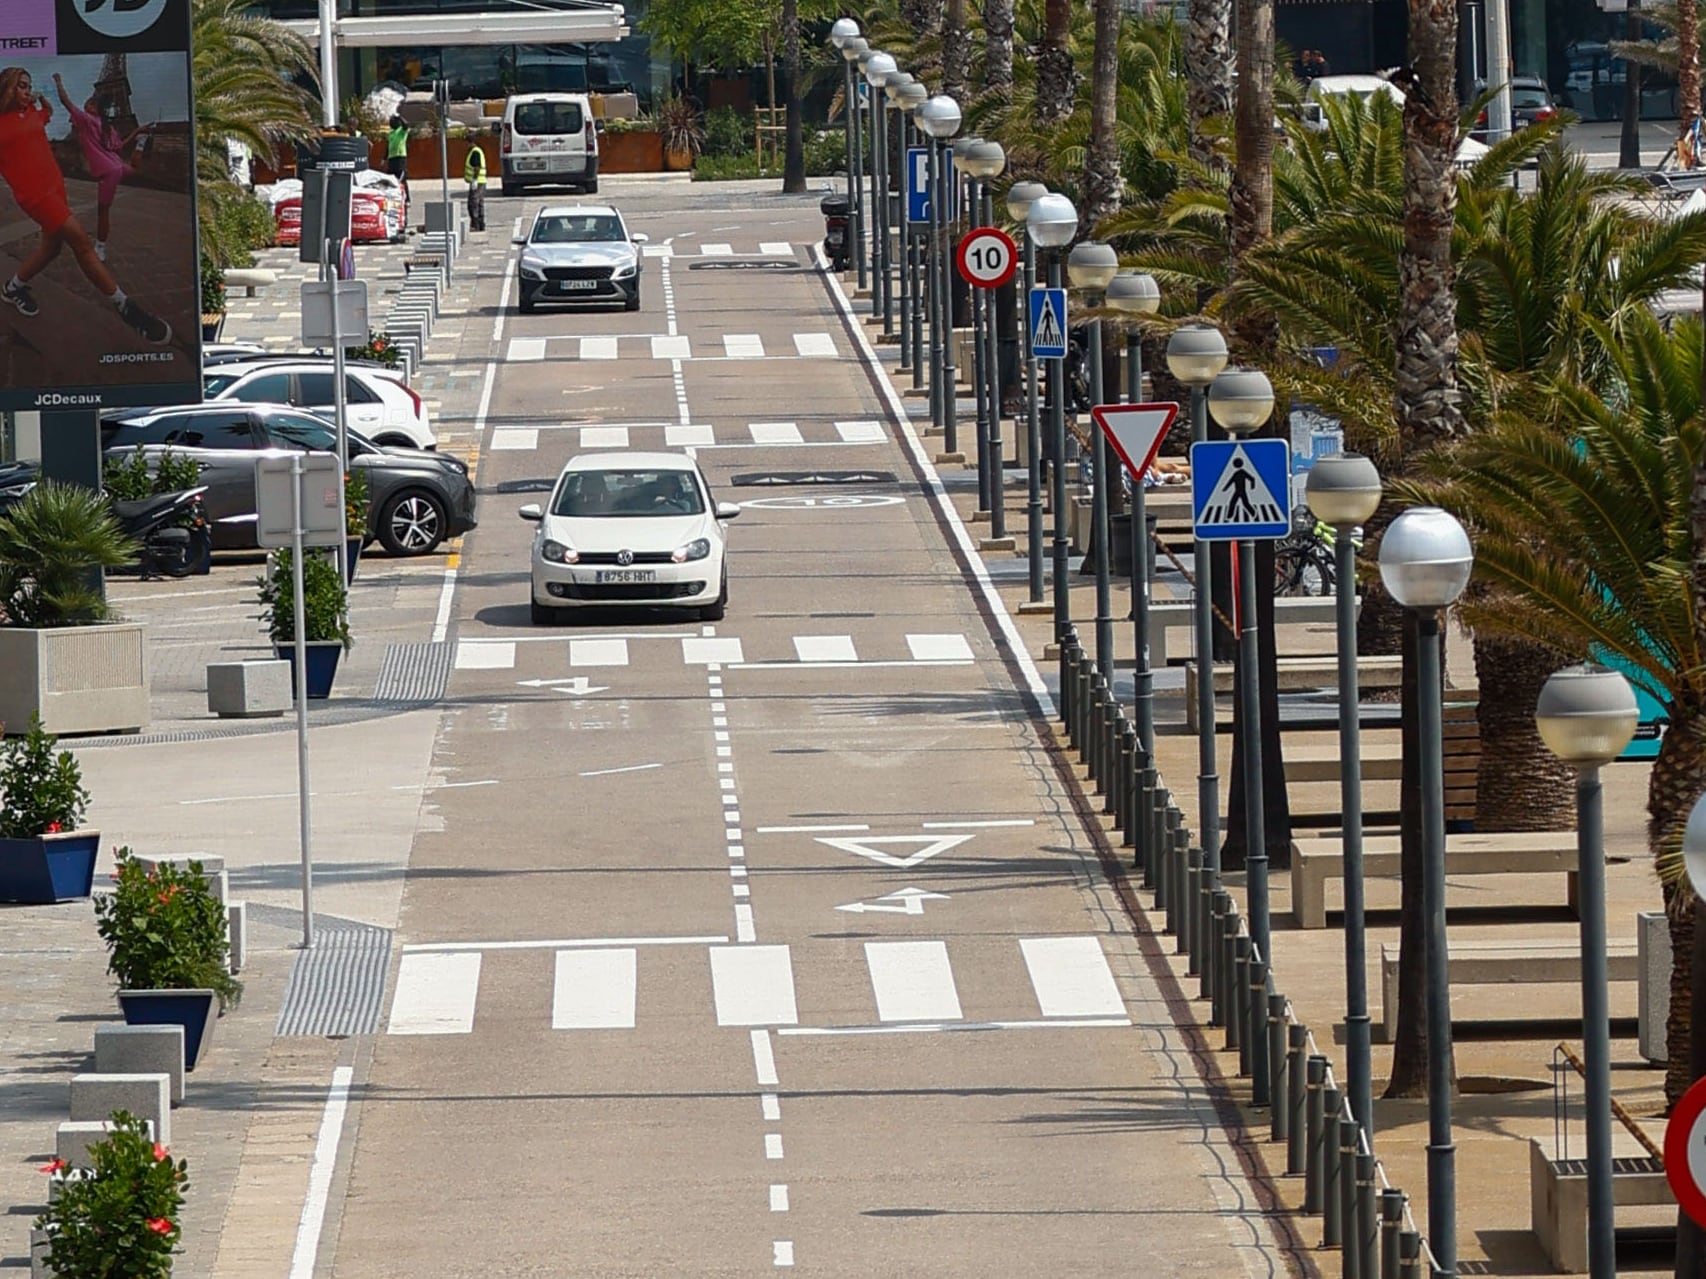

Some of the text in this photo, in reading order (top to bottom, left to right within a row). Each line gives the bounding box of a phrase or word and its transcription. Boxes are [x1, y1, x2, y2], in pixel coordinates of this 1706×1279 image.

[0, 37, 48, 48] TREET
[971, 247, 1001, 270] 10
[34, 393, 102, 406] JCDecaux
